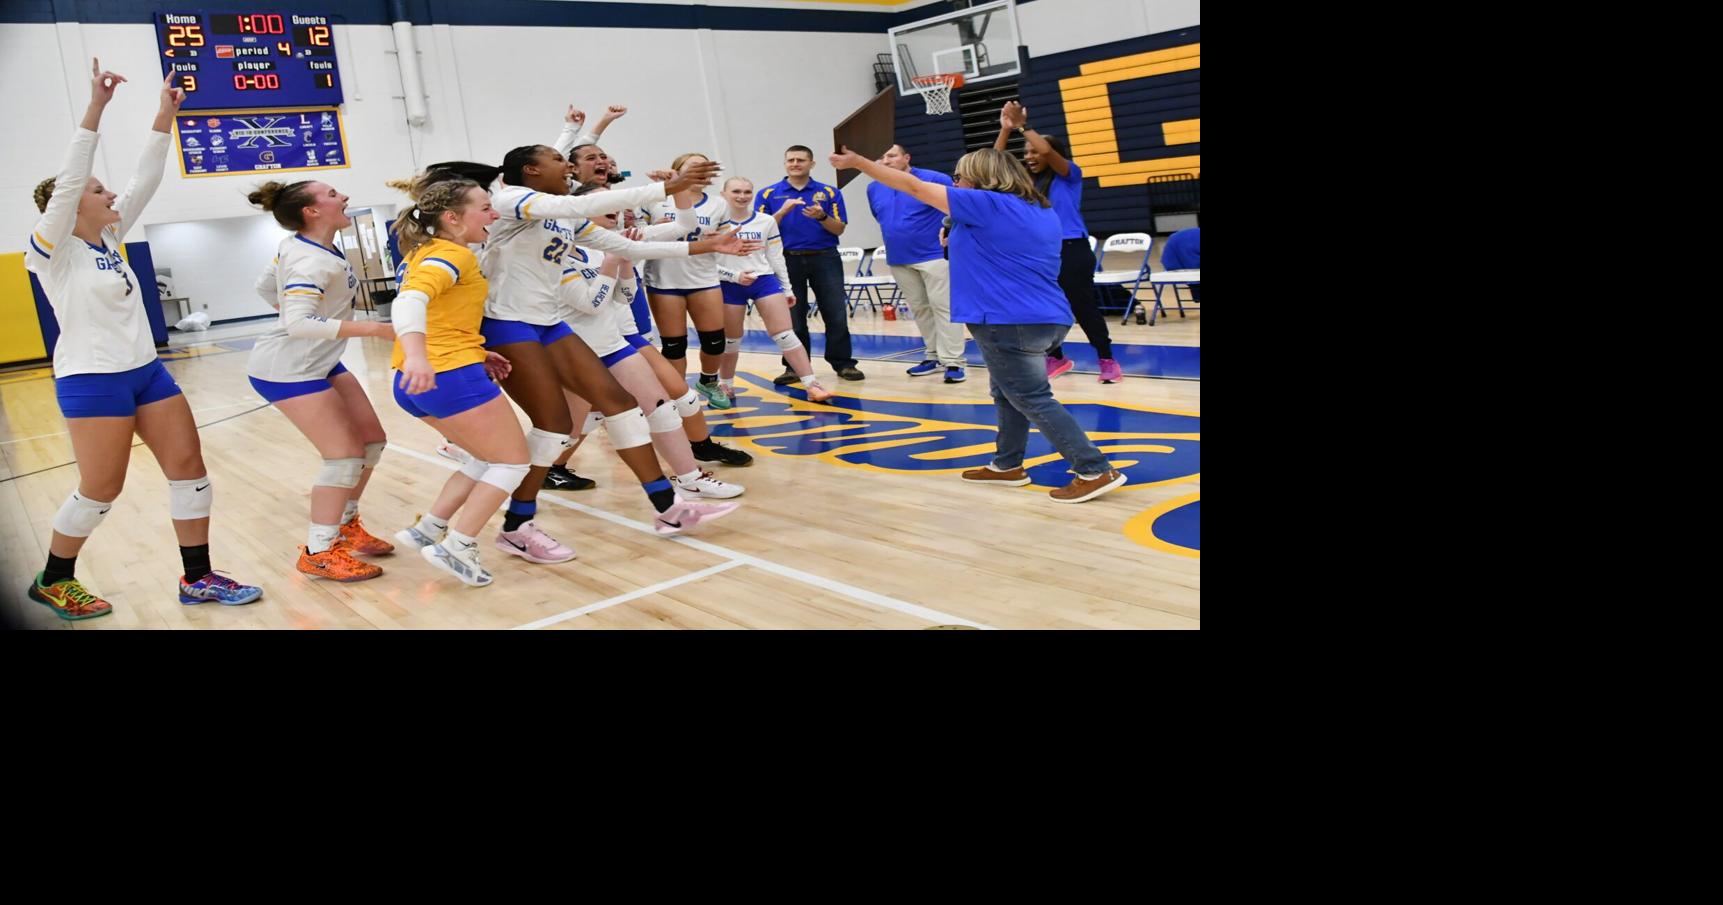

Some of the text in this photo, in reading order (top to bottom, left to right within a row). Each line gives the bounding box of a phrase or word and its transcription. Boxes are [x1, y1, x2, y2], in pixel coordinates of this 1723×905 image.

[165, 14, 197, 24] Home
[237, 14, 284, 34] 1:00
[292, 15, 326, 25] Guests
[169, 25, 204, 46] 25
[308, 26, 330, 46] 12
[235, 46, 269, 57] period
[277, 42, 291, 56] 4
[237, 61, 271, 71] player
[309, 61, 333, 69] fouls
[183, 75, 196, 91] 3
[234, 74, 279, 90] 0-00
[326, 74, 332, 87] 1
[1110, 238, 1144, 246] GRAFTON
